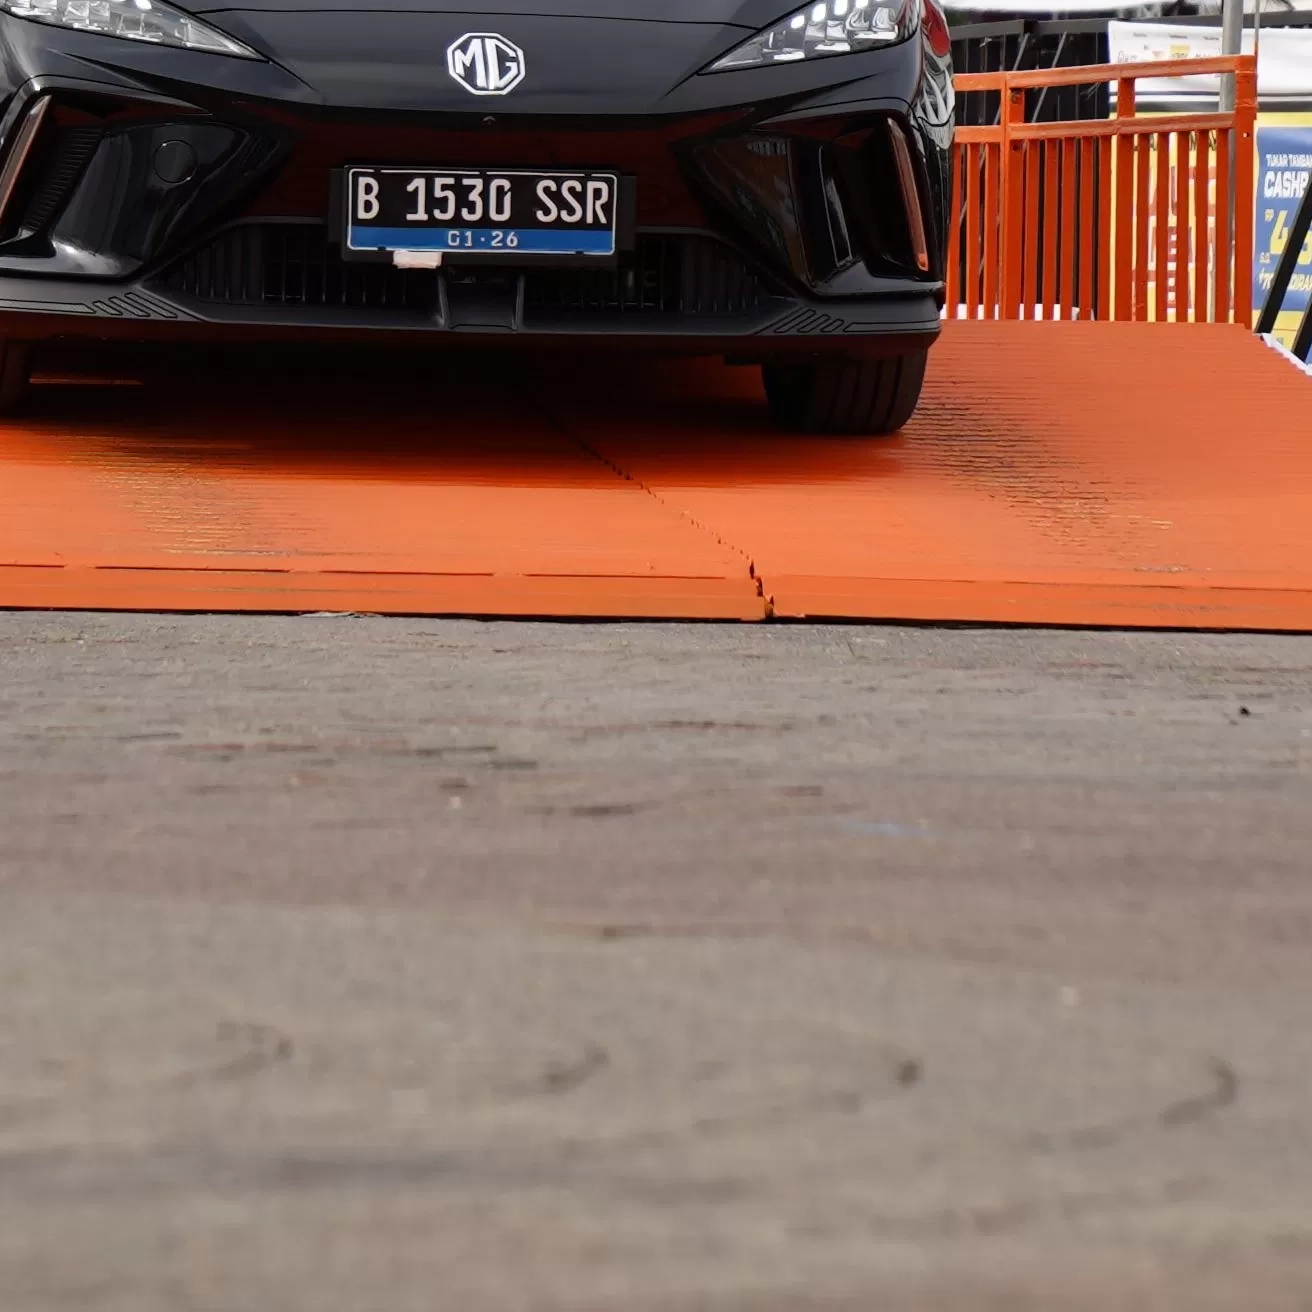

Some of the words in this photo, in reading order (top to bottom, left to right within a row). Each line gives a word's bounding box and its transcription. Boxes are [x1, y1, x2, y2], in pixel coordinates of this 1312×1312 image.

[454, 38, 518, 90] MG
[357, 176, 380, 220] B
[405, 177, 512, 222] 1530
[536, 179, 609, 224] SSR
